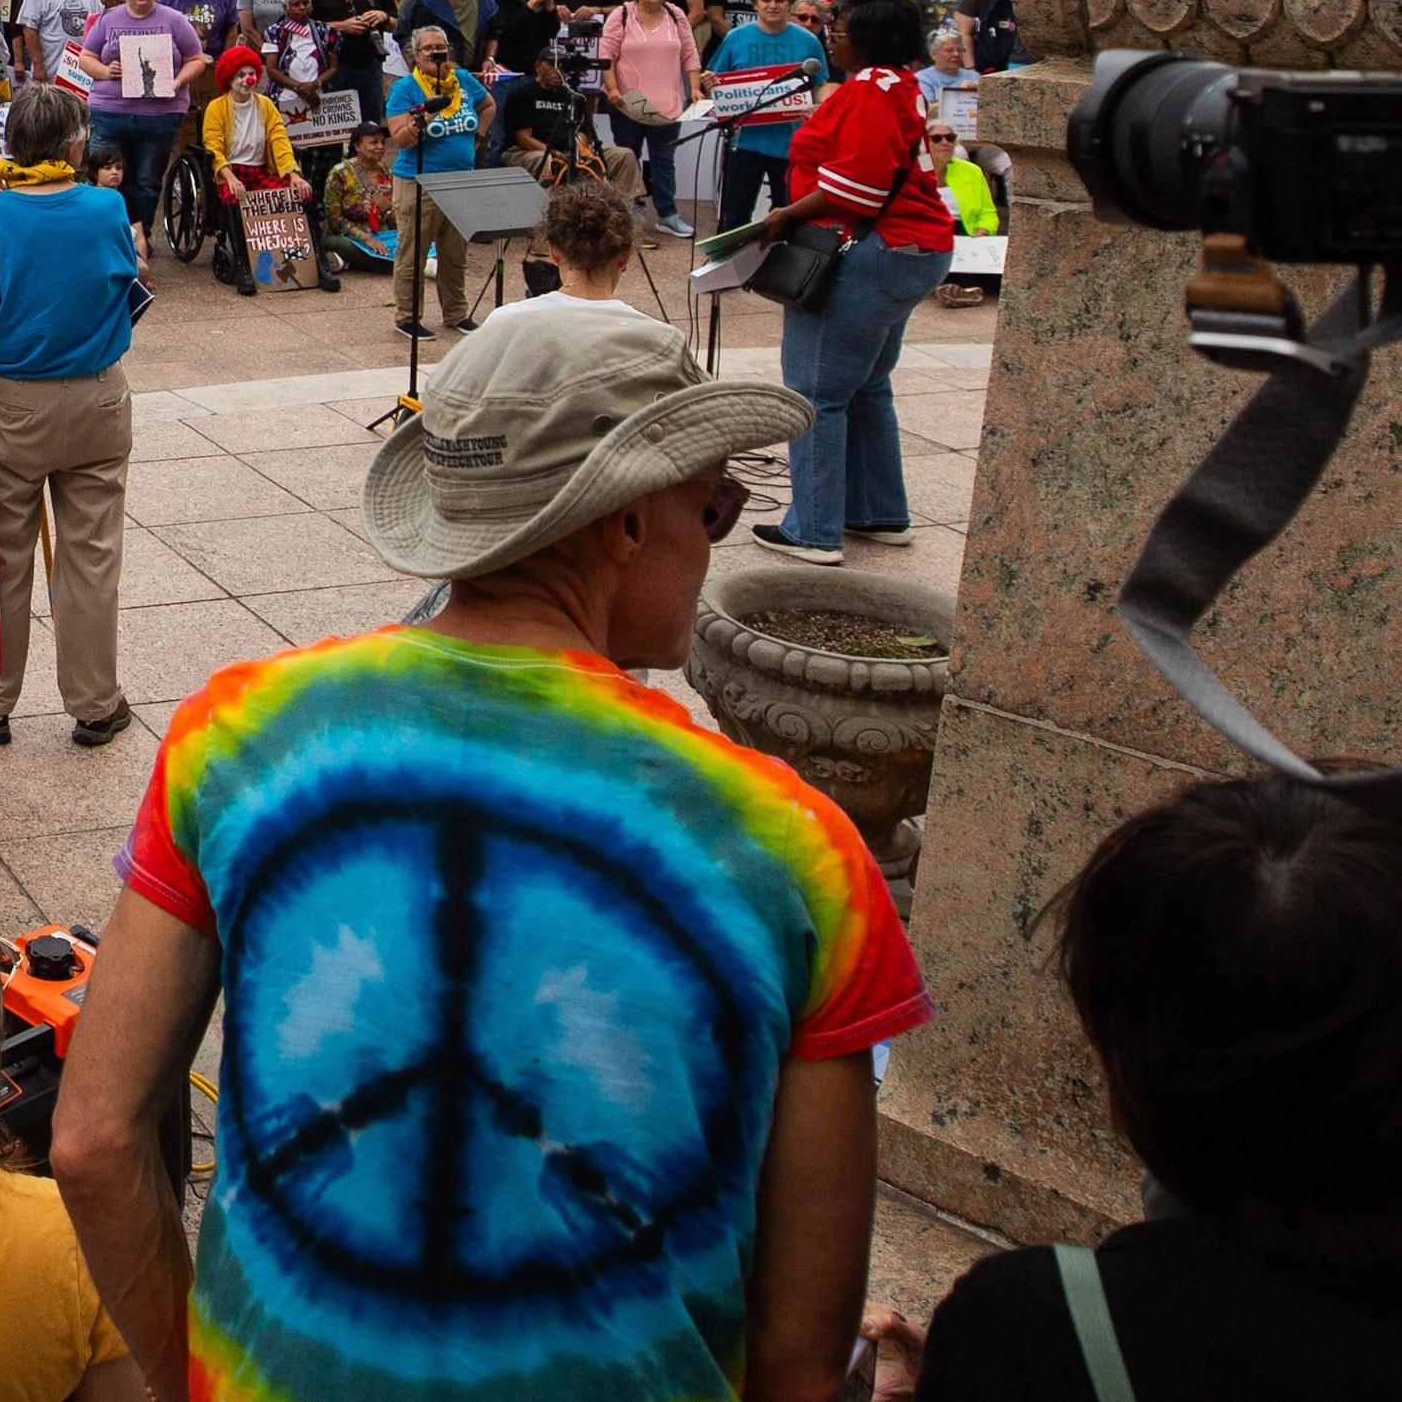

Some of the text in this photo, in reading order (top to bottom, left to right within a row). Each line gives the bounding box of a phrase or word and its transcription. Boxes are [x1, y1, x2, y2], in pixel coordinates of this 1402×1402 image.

[714, 84, 792, 101] Politicians
[717, 94, 808, 114] work US!
[313, 116, 326, 127] NO
[426, 117, 479, 138] OHIO
[246, 217, 305, 236] WHERE IS
[246, 236, 273, 252] THE
